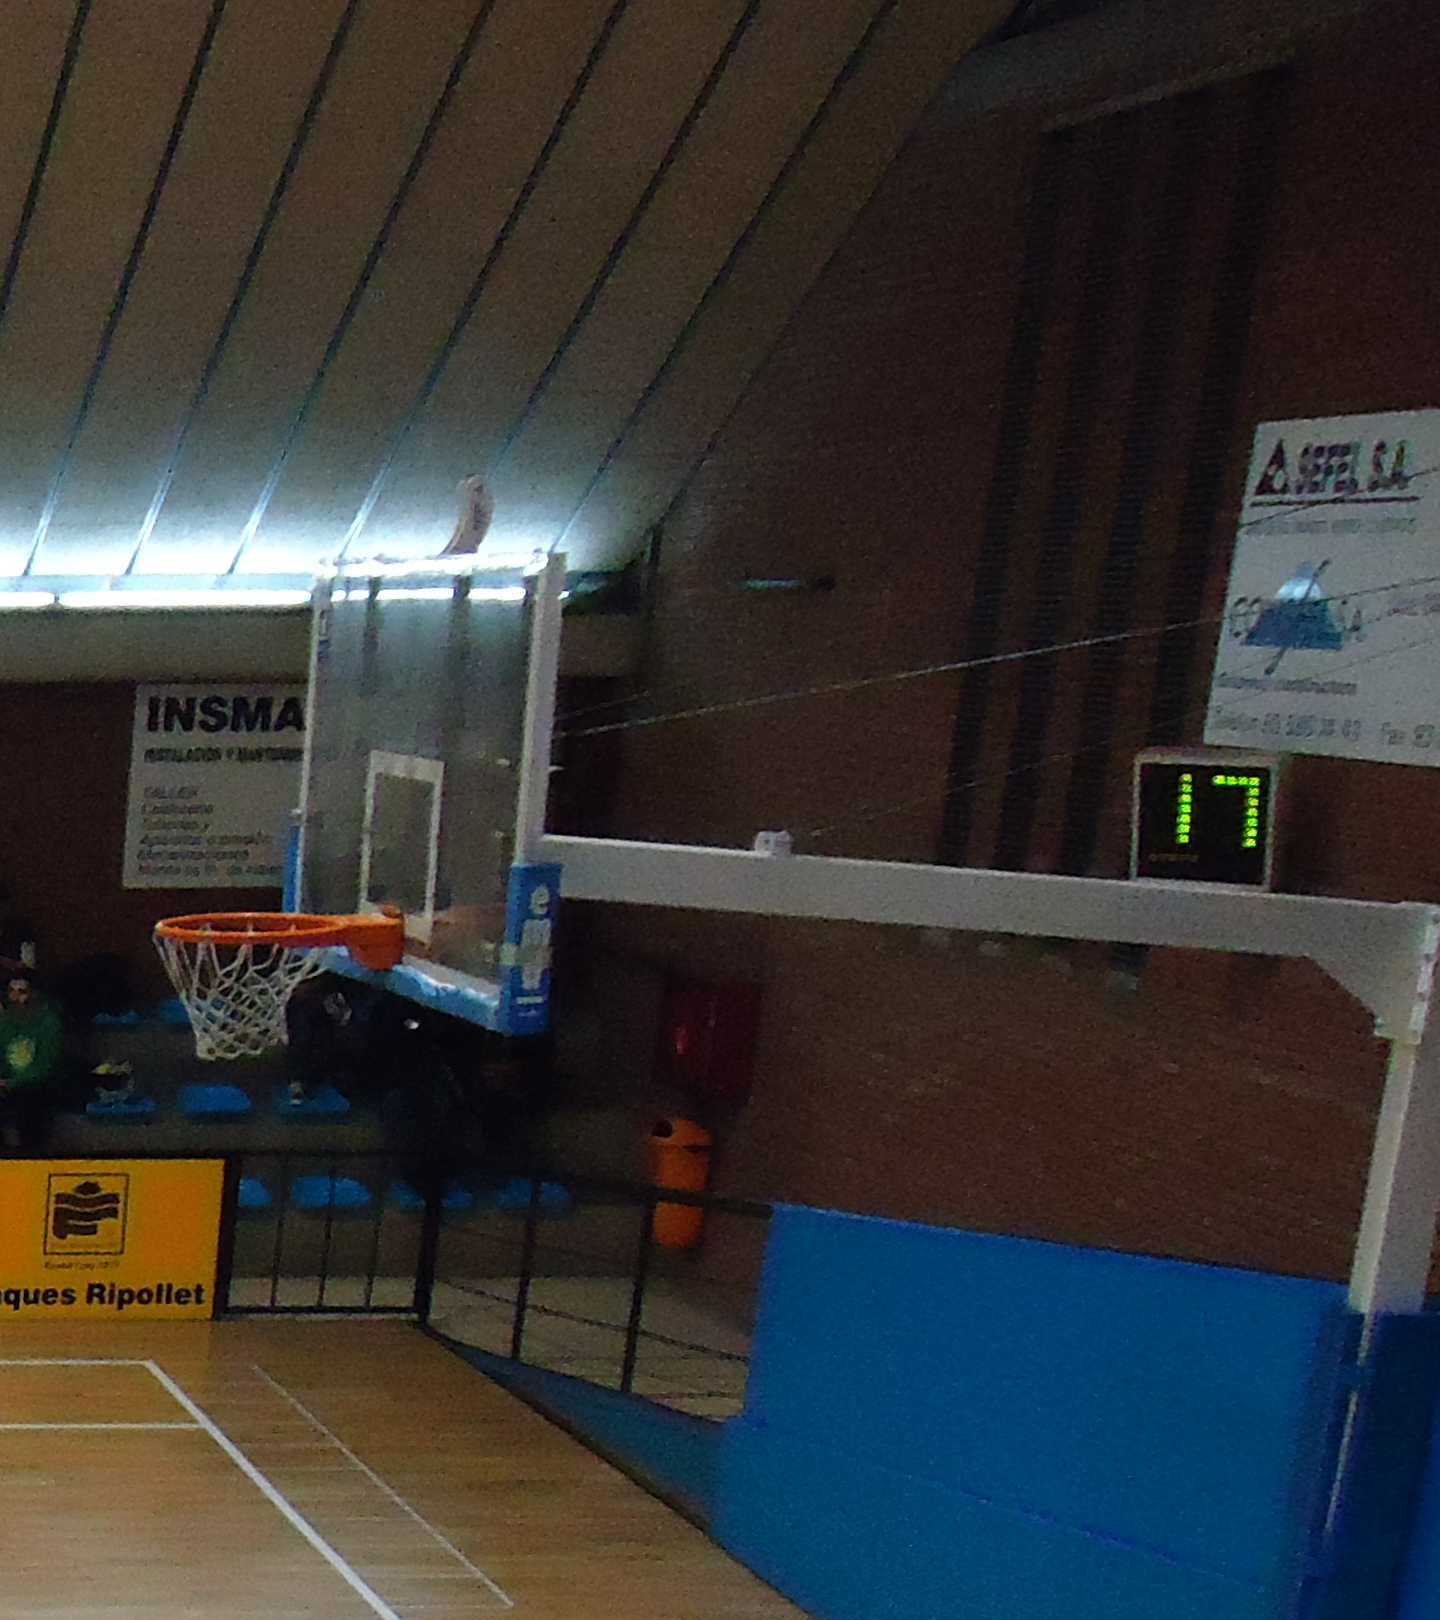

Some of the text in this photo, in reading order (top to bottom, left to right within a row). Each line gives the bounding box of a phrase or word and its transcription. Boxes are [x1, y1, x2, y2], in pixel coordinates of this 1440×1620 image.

[146, 695, 307, 733] INSMA
[1175, 772, 1261, 849] 17
[86, 1282, 205, 1310] Ripollet
